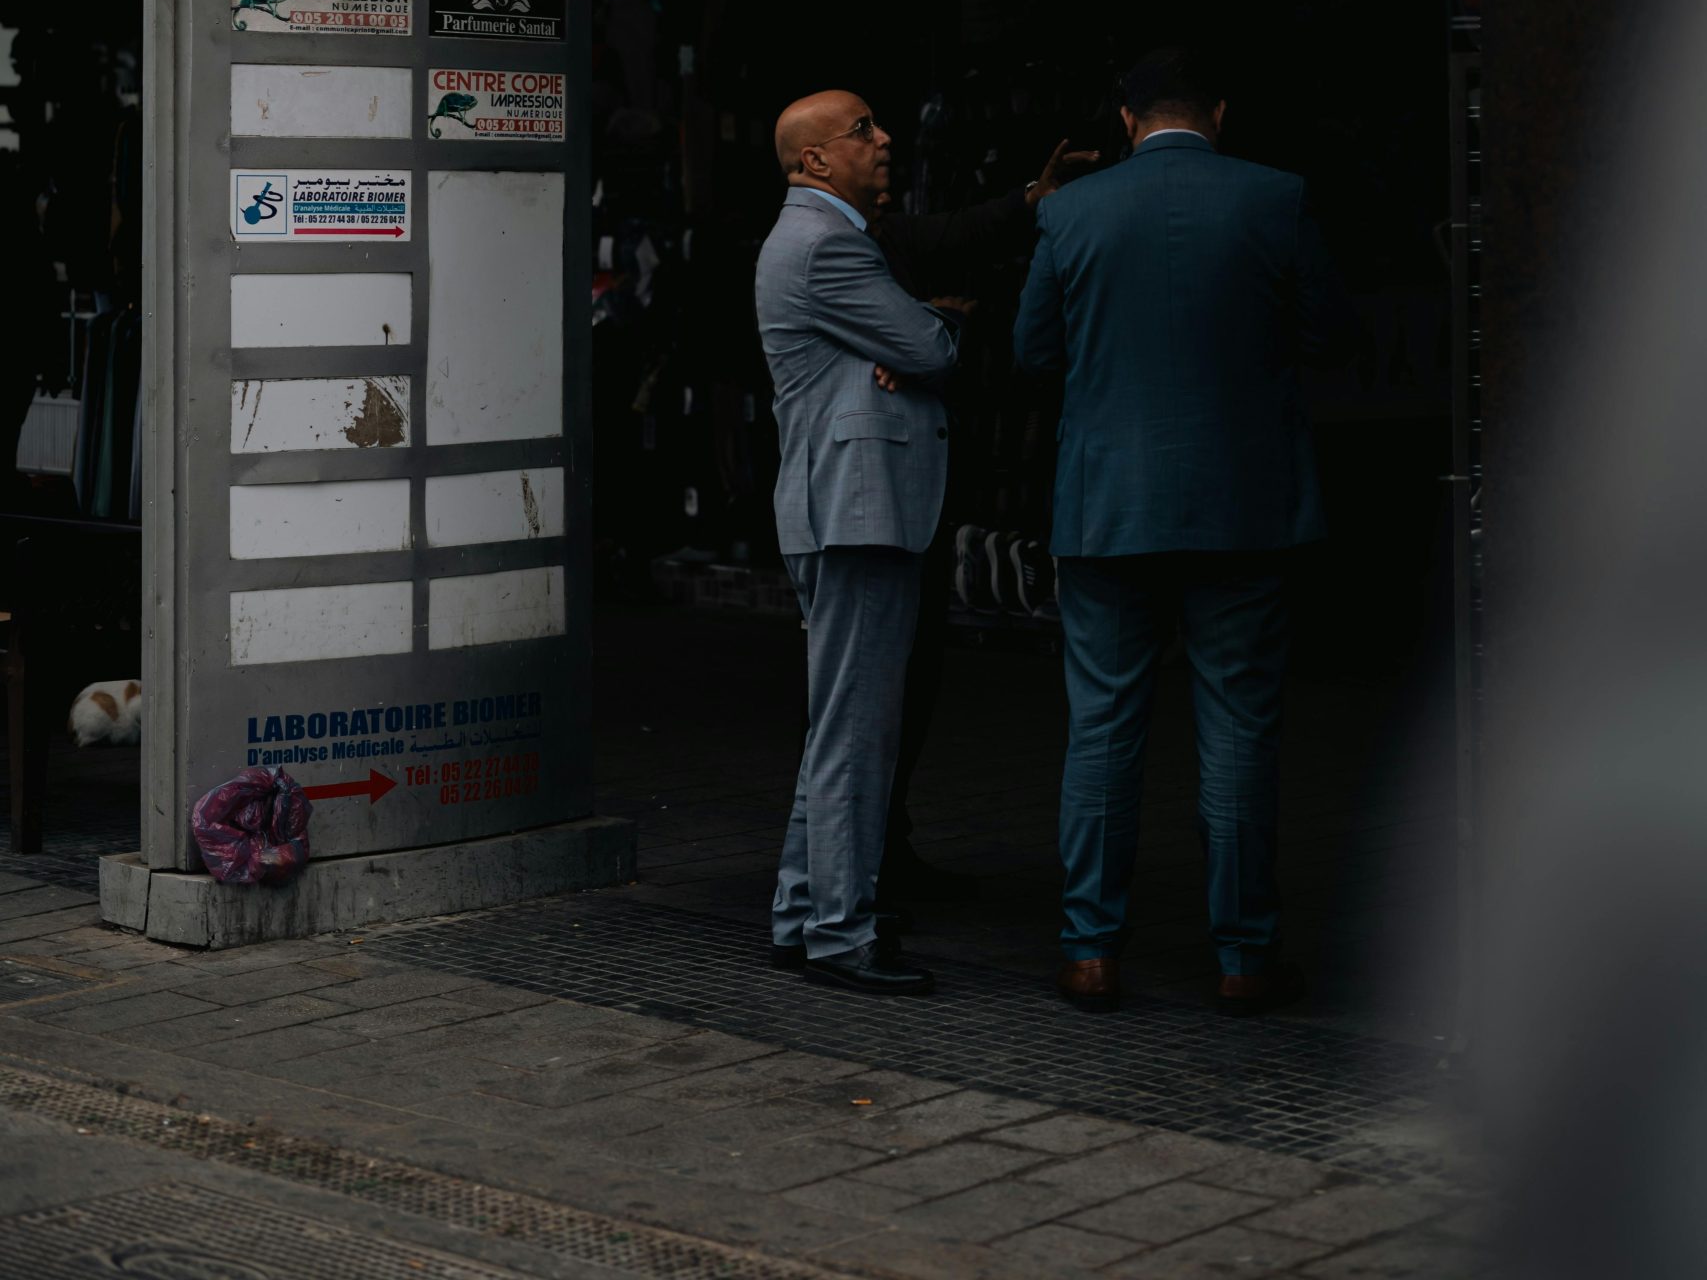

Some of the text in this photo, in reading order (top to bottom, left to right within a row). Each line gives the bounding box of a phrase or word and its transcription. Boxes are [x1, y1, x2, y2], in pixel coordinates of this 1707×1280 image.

[304, 12, 406, 27] 05 20 11 00 05
[443, 14, 555, 36] Parfumerie Santal
[434, 71, 562, 94] CENTRE COPIE
[491, 94, 562, 109] IMPRESSION
[486, 120, 560, 132] 05 20 11 00 05
[354, 174, 405, 190] مختبر
[293, 192, 405, 202] LABORATOIRE BIOMER
[294, 204, 323, 213] D'analyse
[293, 215, 303, 223] Tél
[309, 215, 317, 223] 05
[319, 215, 327, 223] 22
[328, 215, 336, 223] 27
[337, 215, 345, 223] 44
[361, 215, 369, 223] 05
[370, 215, 378, 223] 22
[380, 215, 388, 223] 26
[389, 215, 397, 223] 04
[398, 215, 405, 223] 21
[248, 692, 541, 743] LABORATOIRE BIOMER
[248, 737, 404, 766] D'analyse Médicale
[406, 765, 430, 786] Tél
[442, 762, 460, 783] 05
[464, 760, 481, 780] 22
[485, 757, 500, 778] 27
[441, 784, 459, 805] 05
[464, 782, 480, 801] 22
[485, 780, 500, 799] 26
